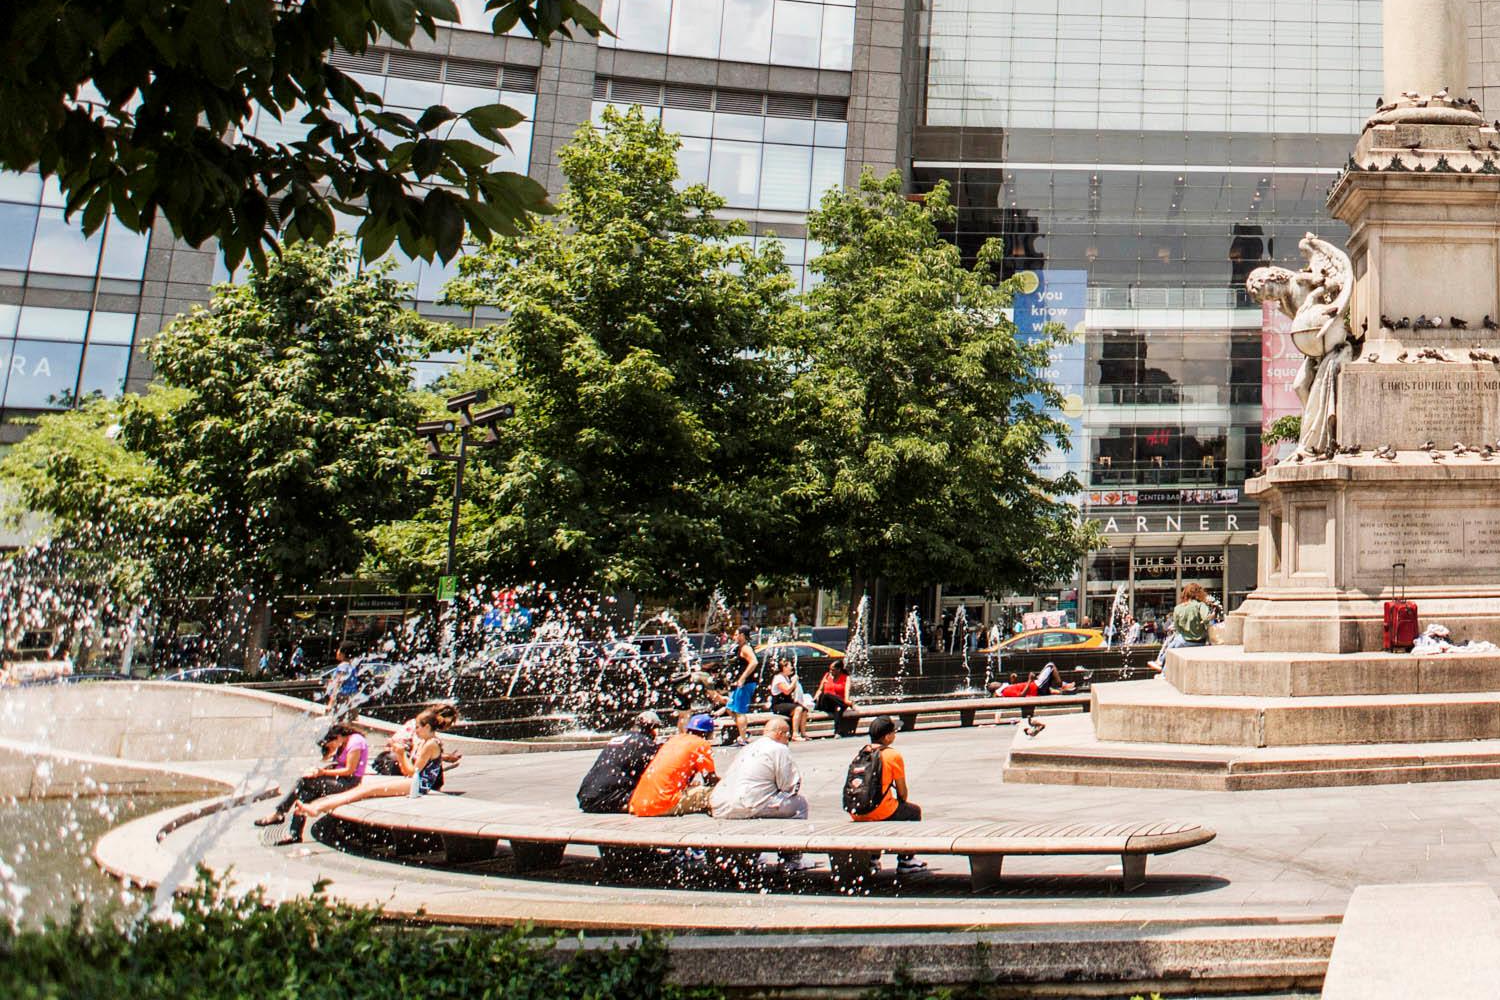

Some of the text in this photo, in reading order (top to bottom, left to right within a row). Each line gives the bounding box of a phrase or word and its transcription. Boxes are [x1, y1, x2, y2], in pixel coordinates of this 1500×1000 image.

[1037, 291, 1063, 302] you
[1031, 305, 1068, 316] know
[1381, 380, 1452, 391] CHRISTOPHER
[1138, 493, 1165, 501] CENTER
[1134, 555, 1225, 567] THE SHOPS
